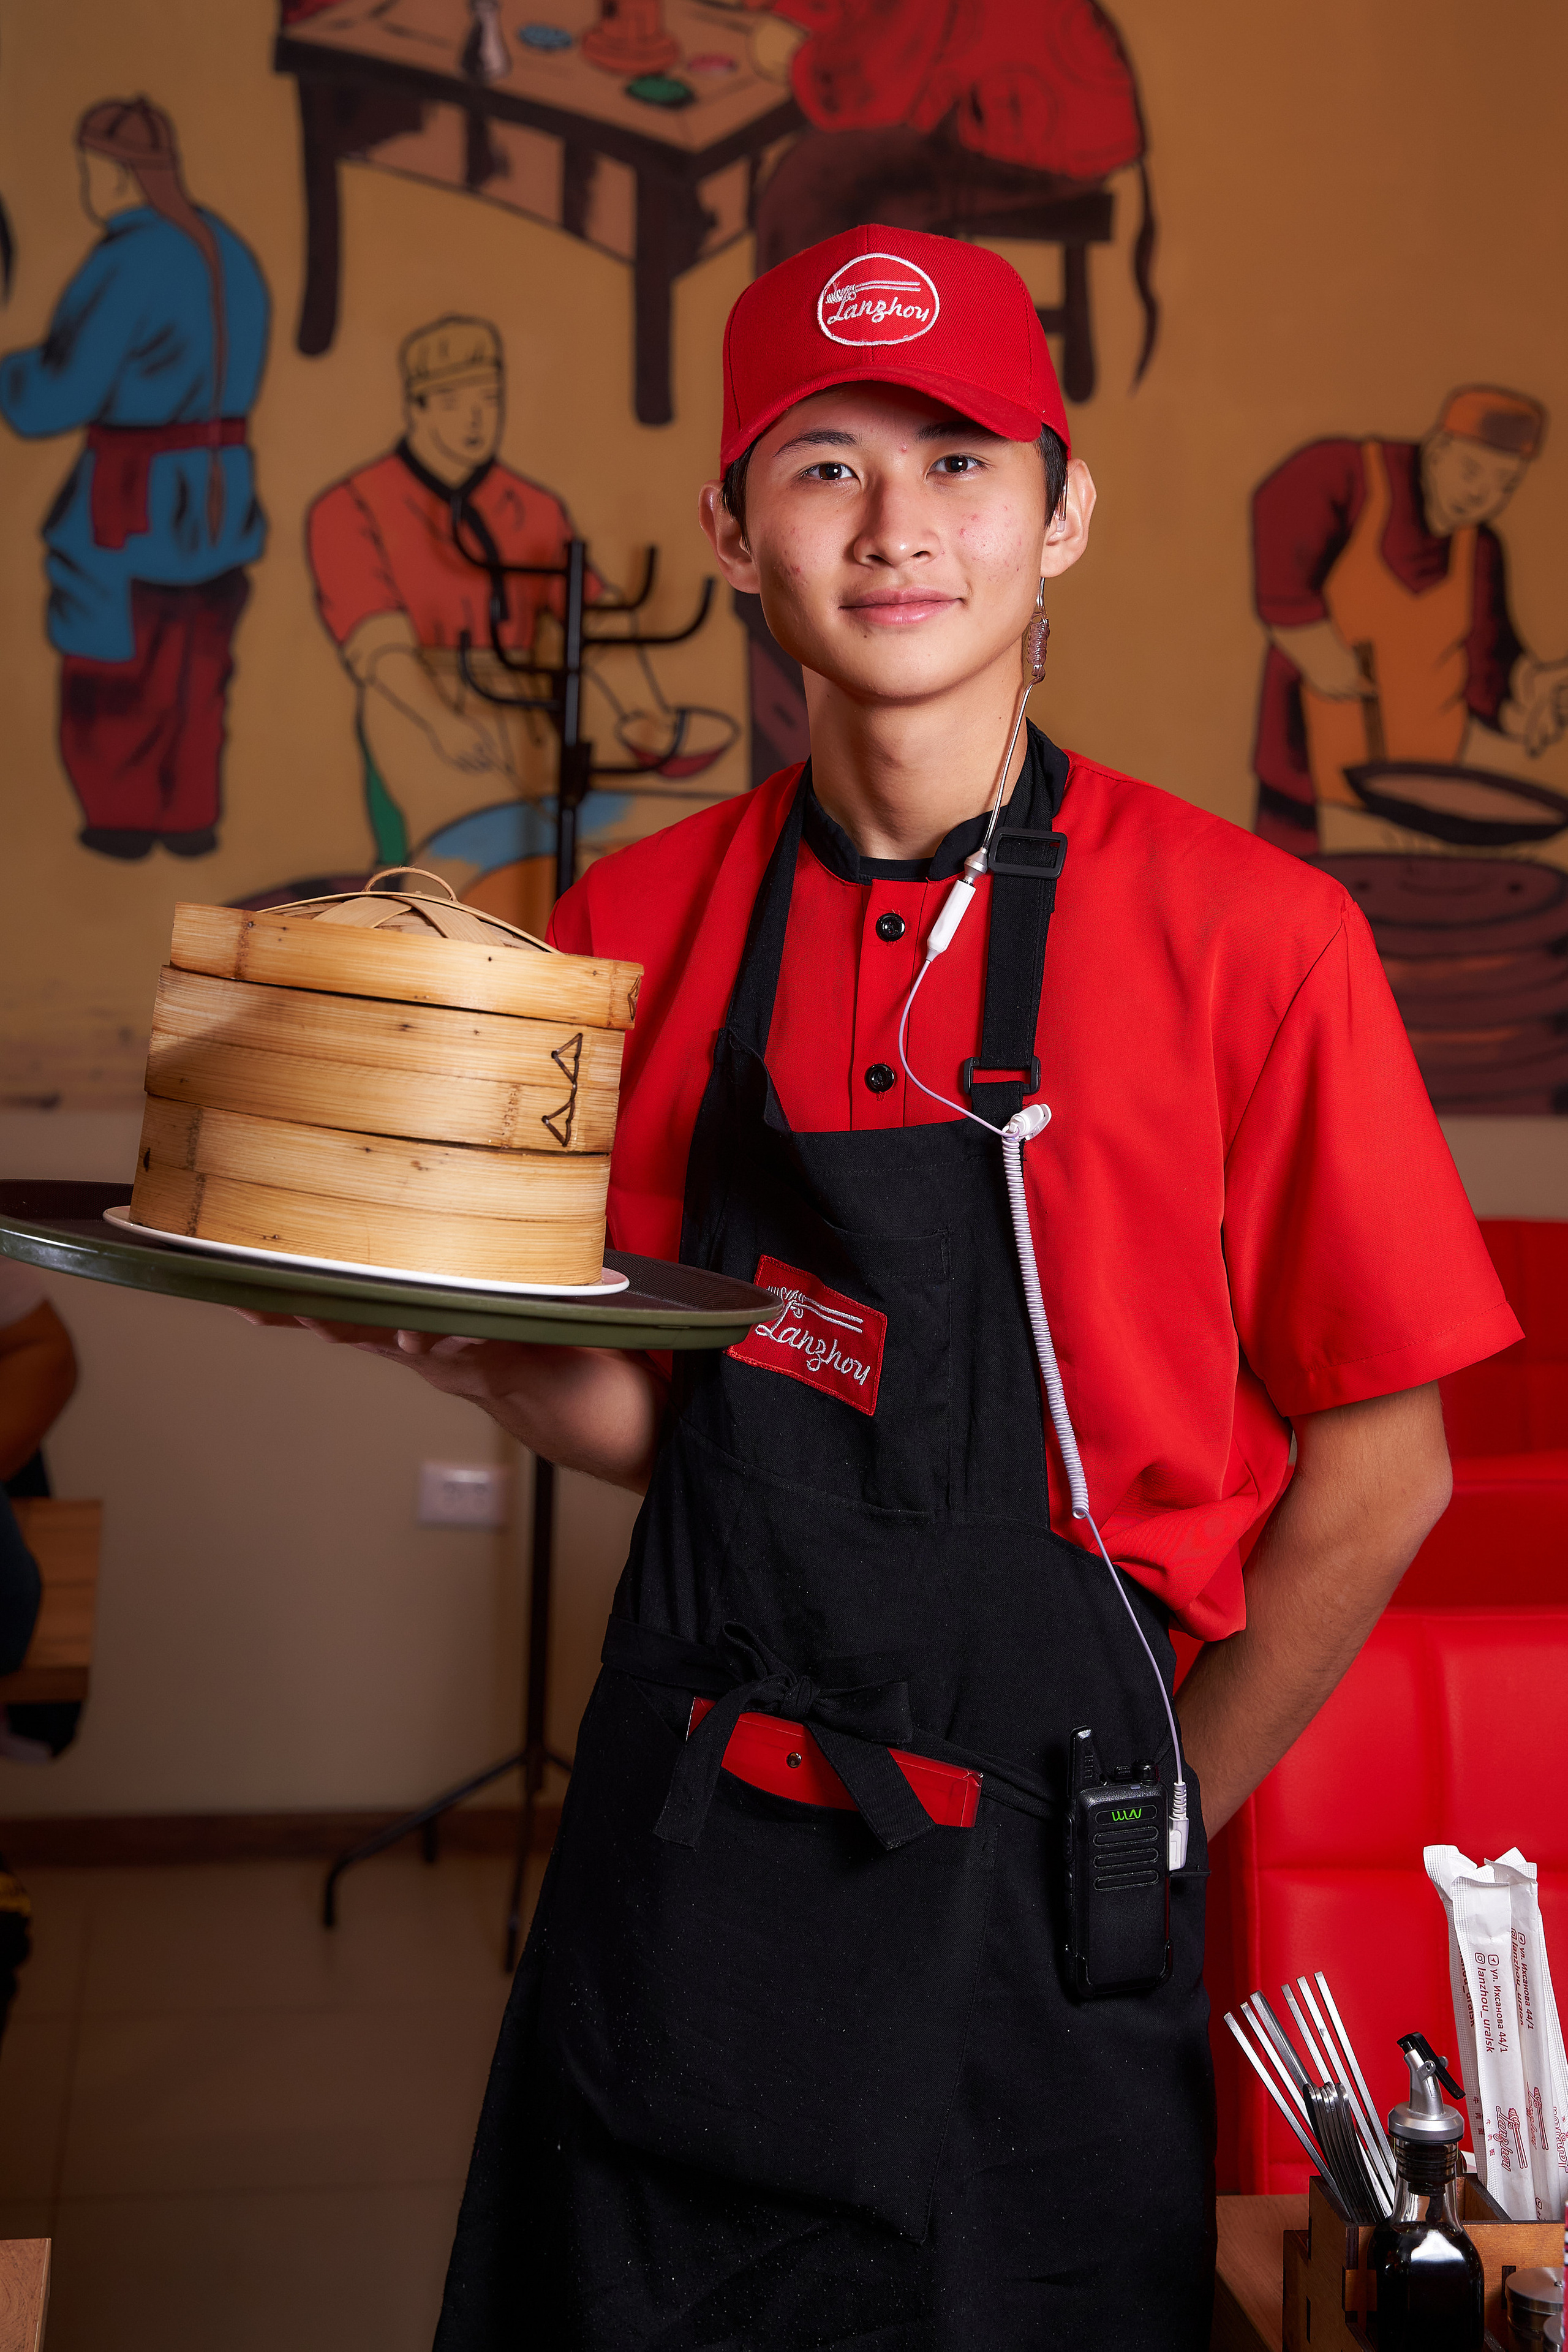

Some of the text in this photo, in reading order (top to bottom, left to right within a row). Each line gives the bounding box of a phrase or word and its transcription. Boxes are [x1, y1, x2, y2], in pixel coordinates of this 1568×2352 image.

[1493, 1985, 1504, 2029] Ихсанова
[1521, 1962, 1531, 2007] Ихсанова
[1477, 1967, 1495, 2053] lanzhou_uralsk
[1498, 2031, 1508, 2052] 44/1
[1493, 2106, 1514, 2172] Lanzhou
